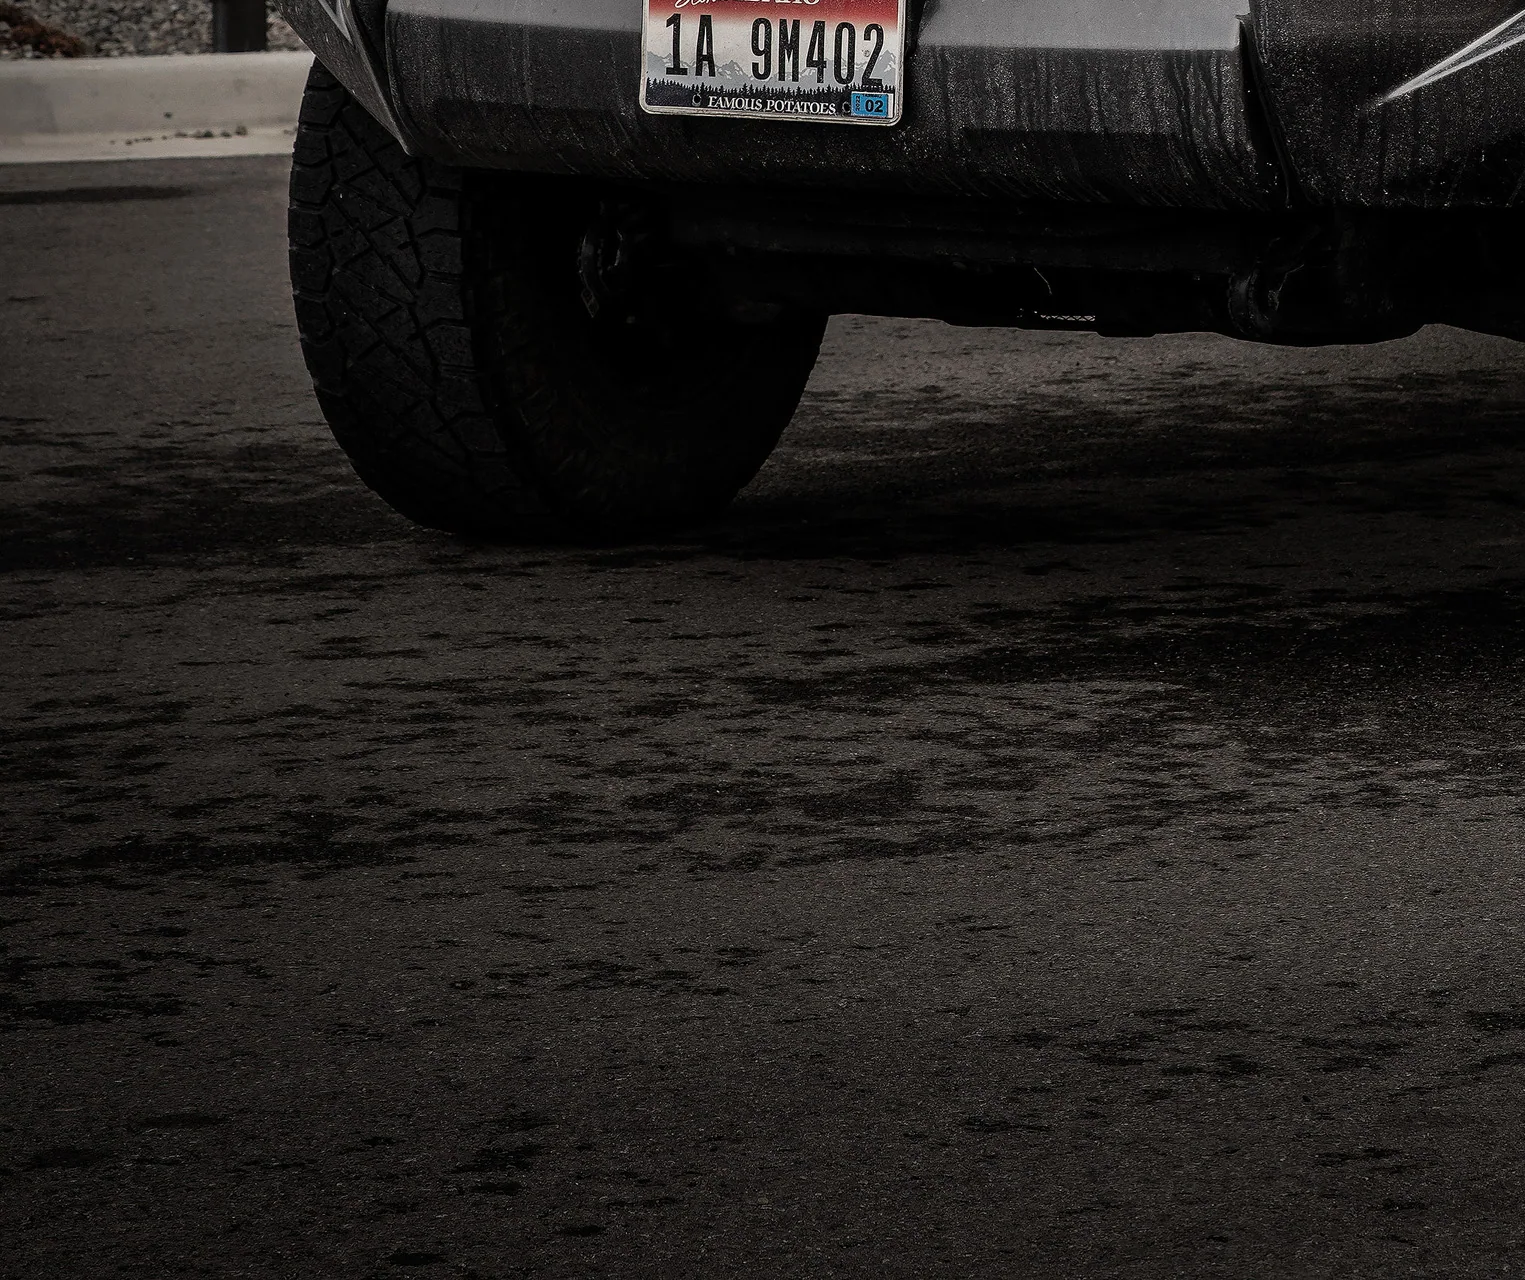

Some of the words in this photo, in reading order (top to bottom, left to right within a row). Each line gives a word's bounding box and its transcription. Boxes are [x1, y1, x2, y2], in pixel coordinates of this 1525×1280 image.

[665, 12, 717, 77] 1A
[751, 17, 885, 91] 9M402
[707, 96, 763, 114] FAMOUS
[766, 98, 836, 115] POTATOES
[865, 99, 884, 113] 02
